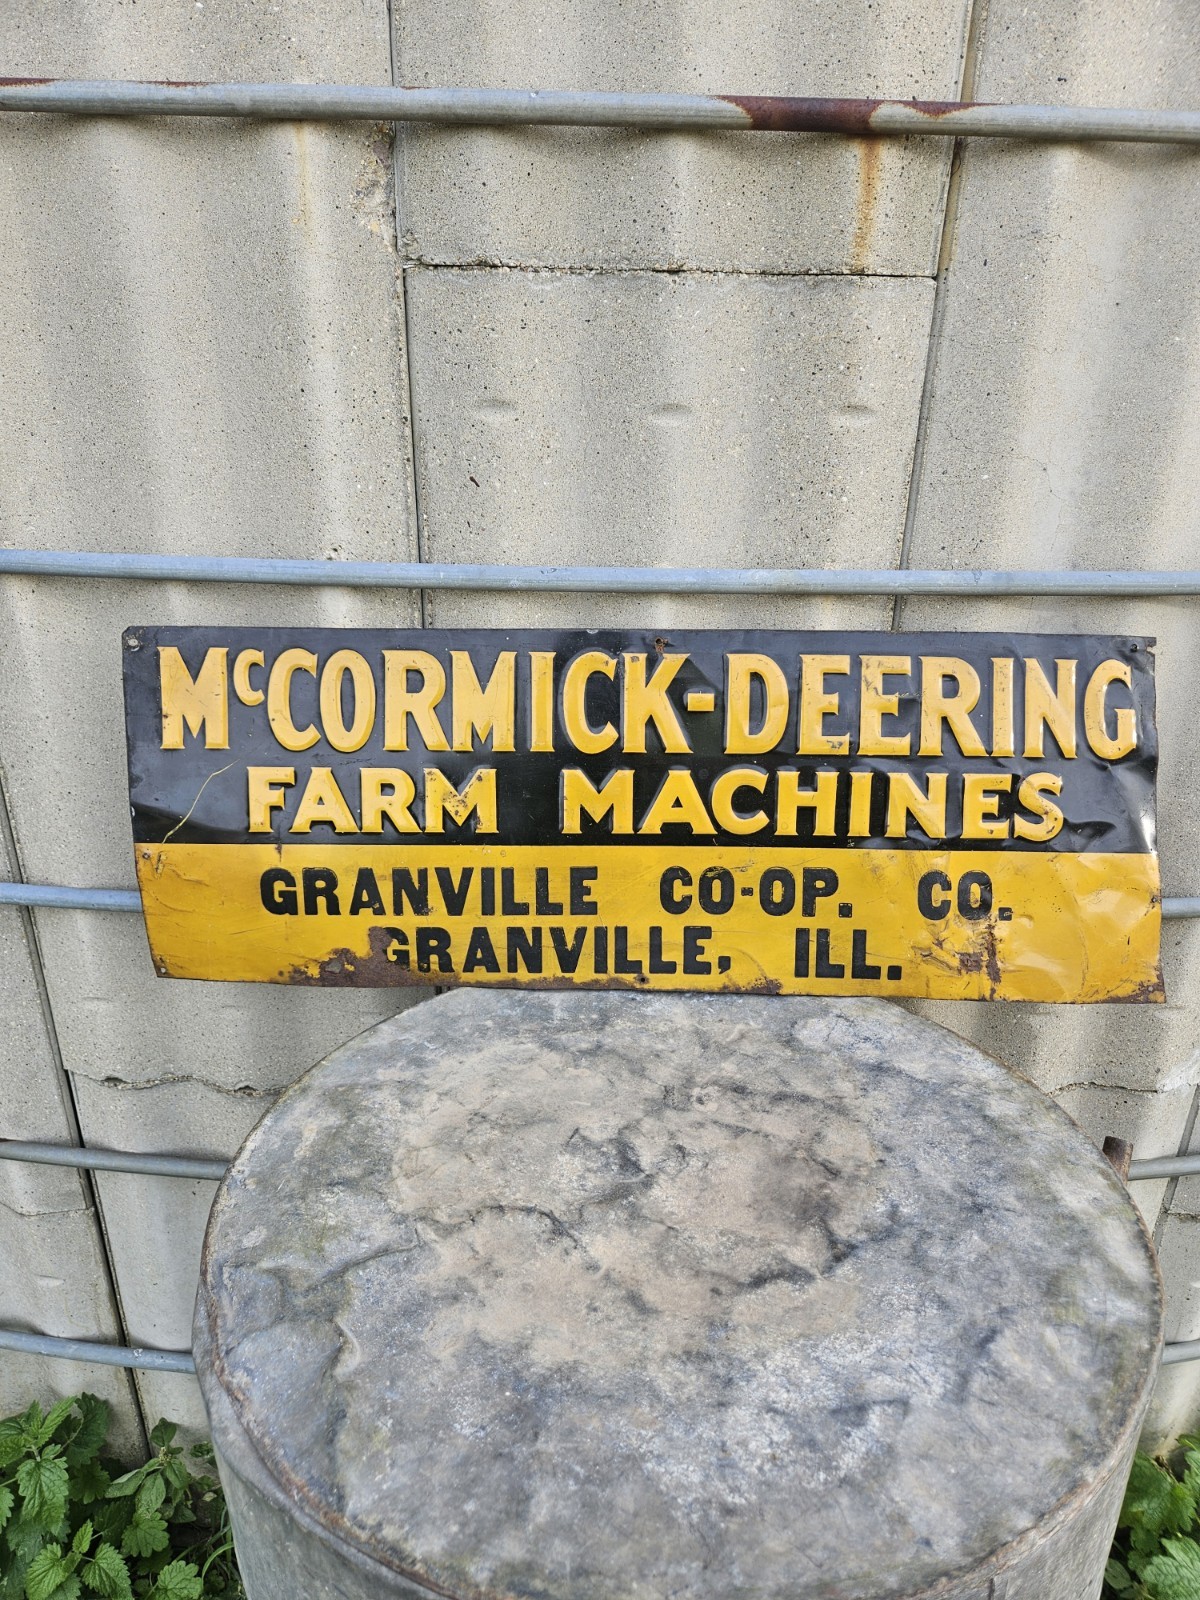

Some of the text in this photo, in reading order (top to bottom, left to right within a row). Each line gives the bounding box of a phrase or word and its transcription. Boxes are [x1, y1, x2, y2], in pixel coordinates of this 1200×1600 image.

[247, 767, 1064, 842] FARM MACHINES
[260, 866, 1013, 921] GRANVILLE CO-OP. CO.
[380, 925, 902, 980] GRANVILLE, ILL.
